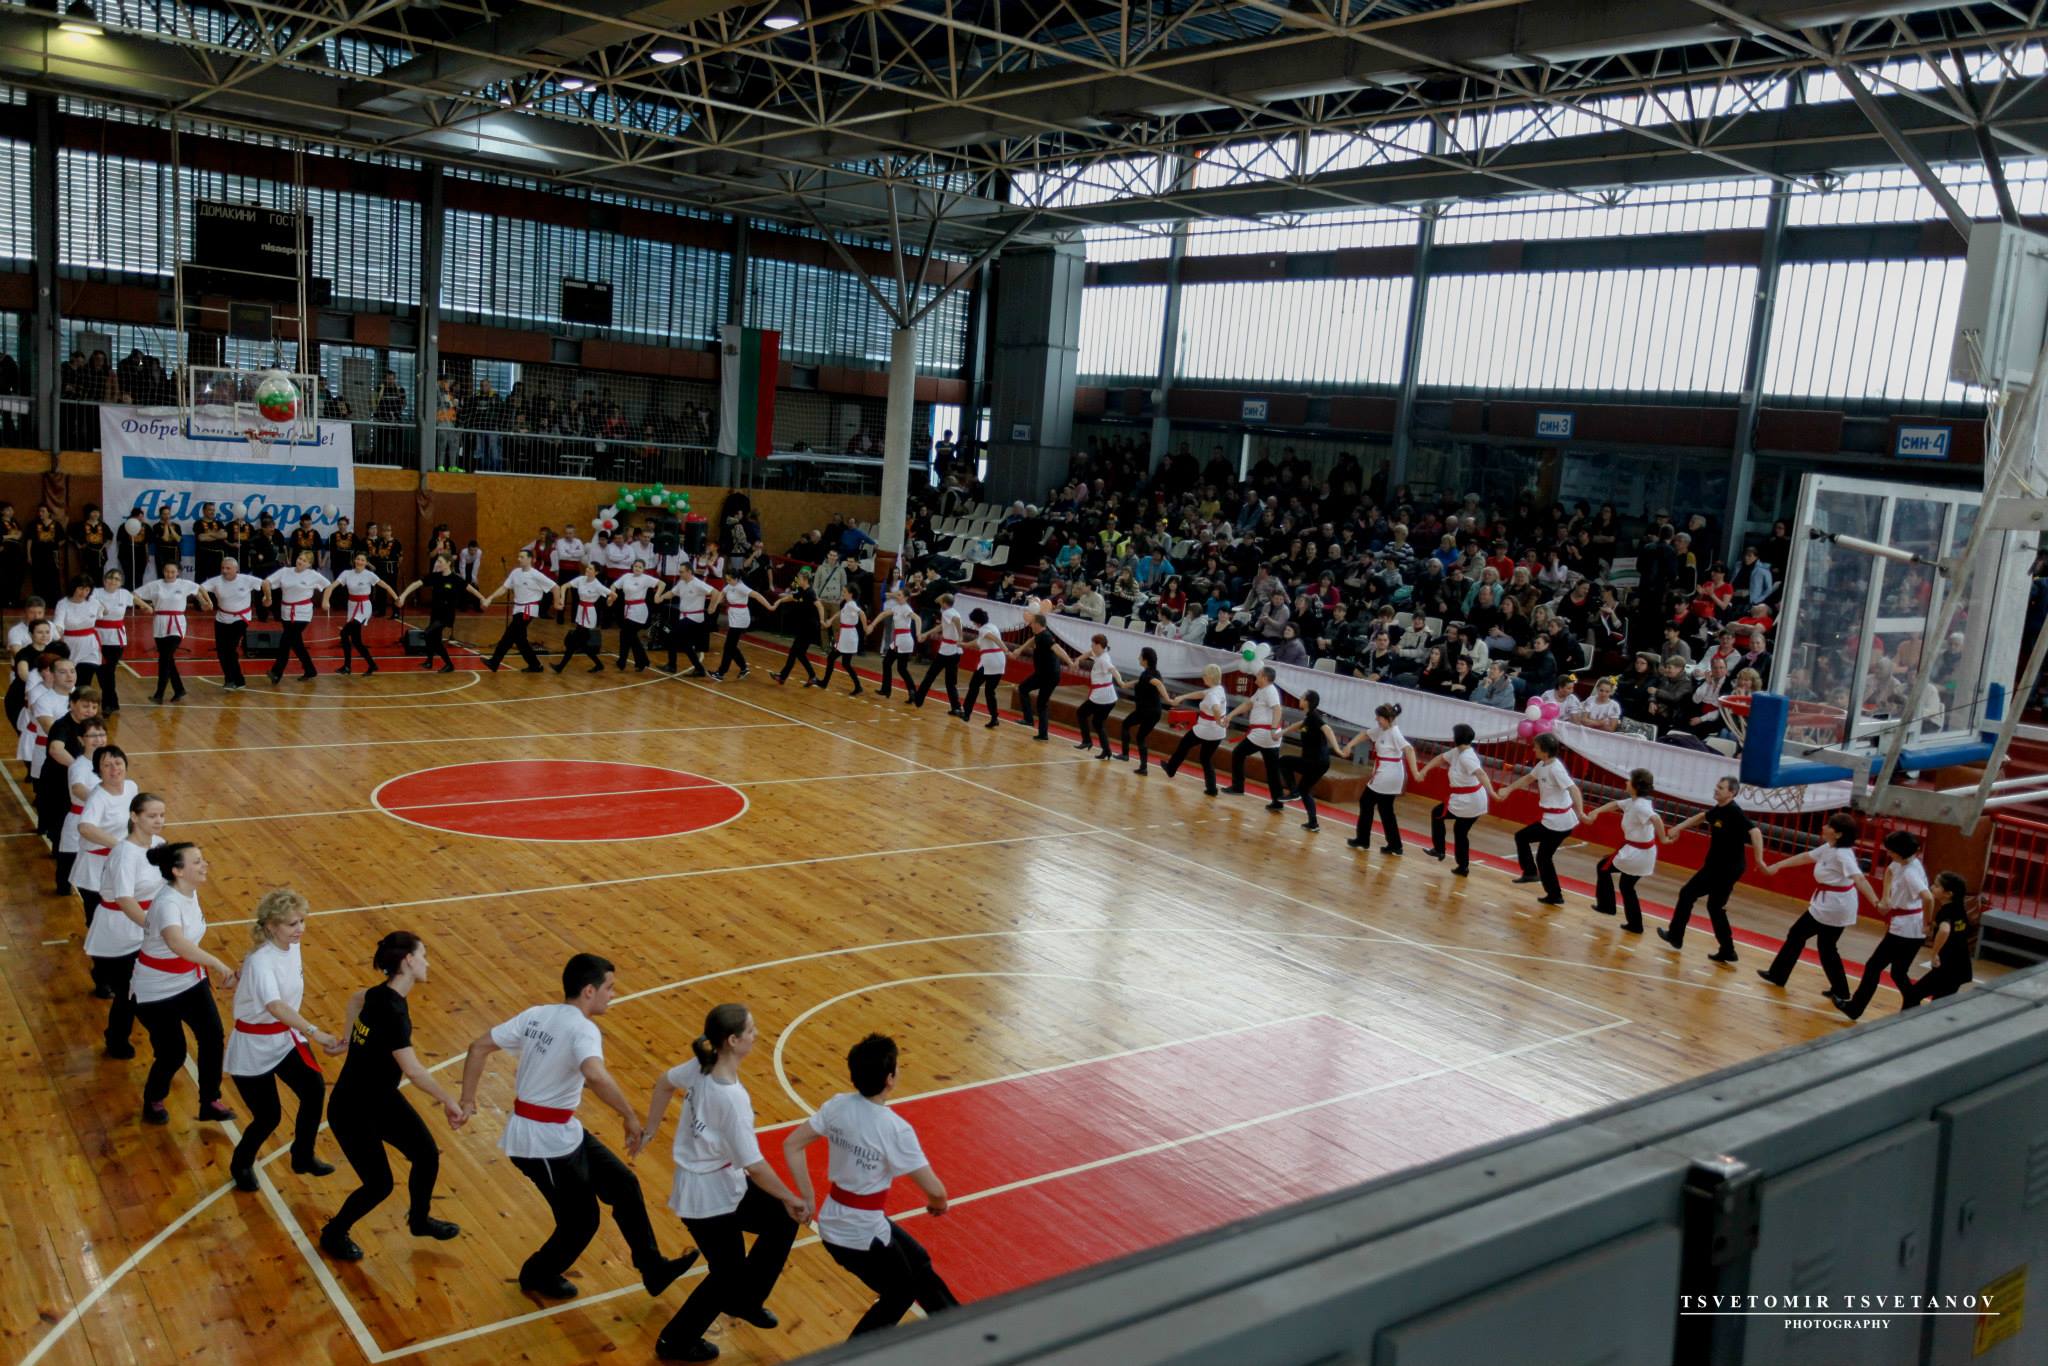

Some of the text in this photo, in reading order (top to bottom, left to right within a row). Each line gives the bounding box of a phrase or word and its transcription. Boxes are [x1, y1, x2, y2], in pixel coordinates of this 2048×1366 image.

[200, 203, 256, 222] ДОМАКИНИ
[260, 242, 309, 256] nisaspo
[121, 418, 178, 442] Добре
[122, 489, 233, 523] Atlas
